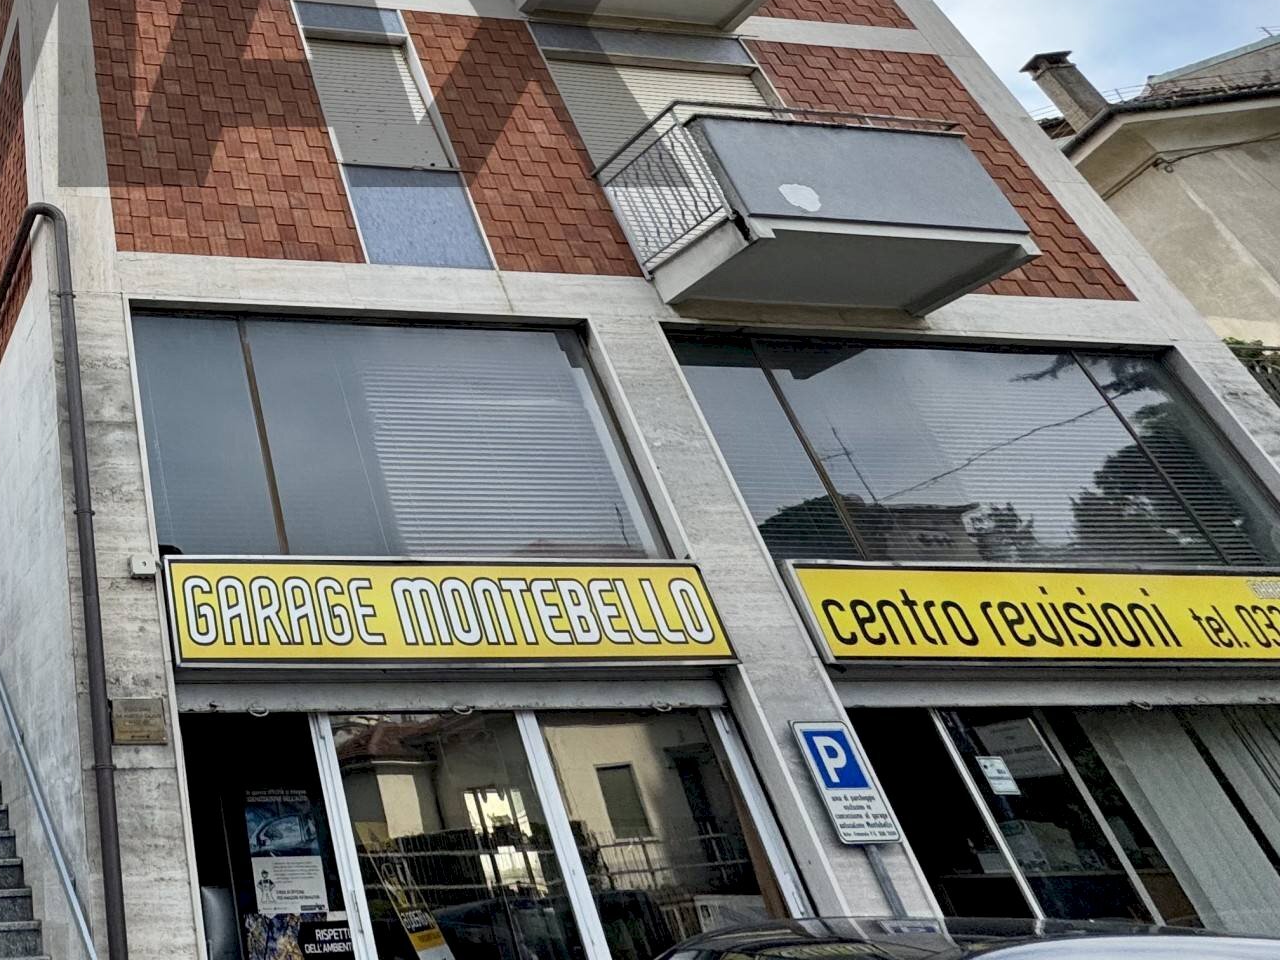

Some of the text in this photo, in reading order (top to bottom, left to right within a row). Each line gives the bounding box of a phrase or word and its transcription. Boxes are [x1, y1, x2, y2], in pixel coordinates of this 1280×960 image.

[182, 575, 717, 647] GARAGE MONTEBELLO
[821, 588, 980, 647] centro
[981, 586, 1183, 648] revisioni
[812, 736, 847, 782] P
[314, 927, 352, 941] RISPETT
